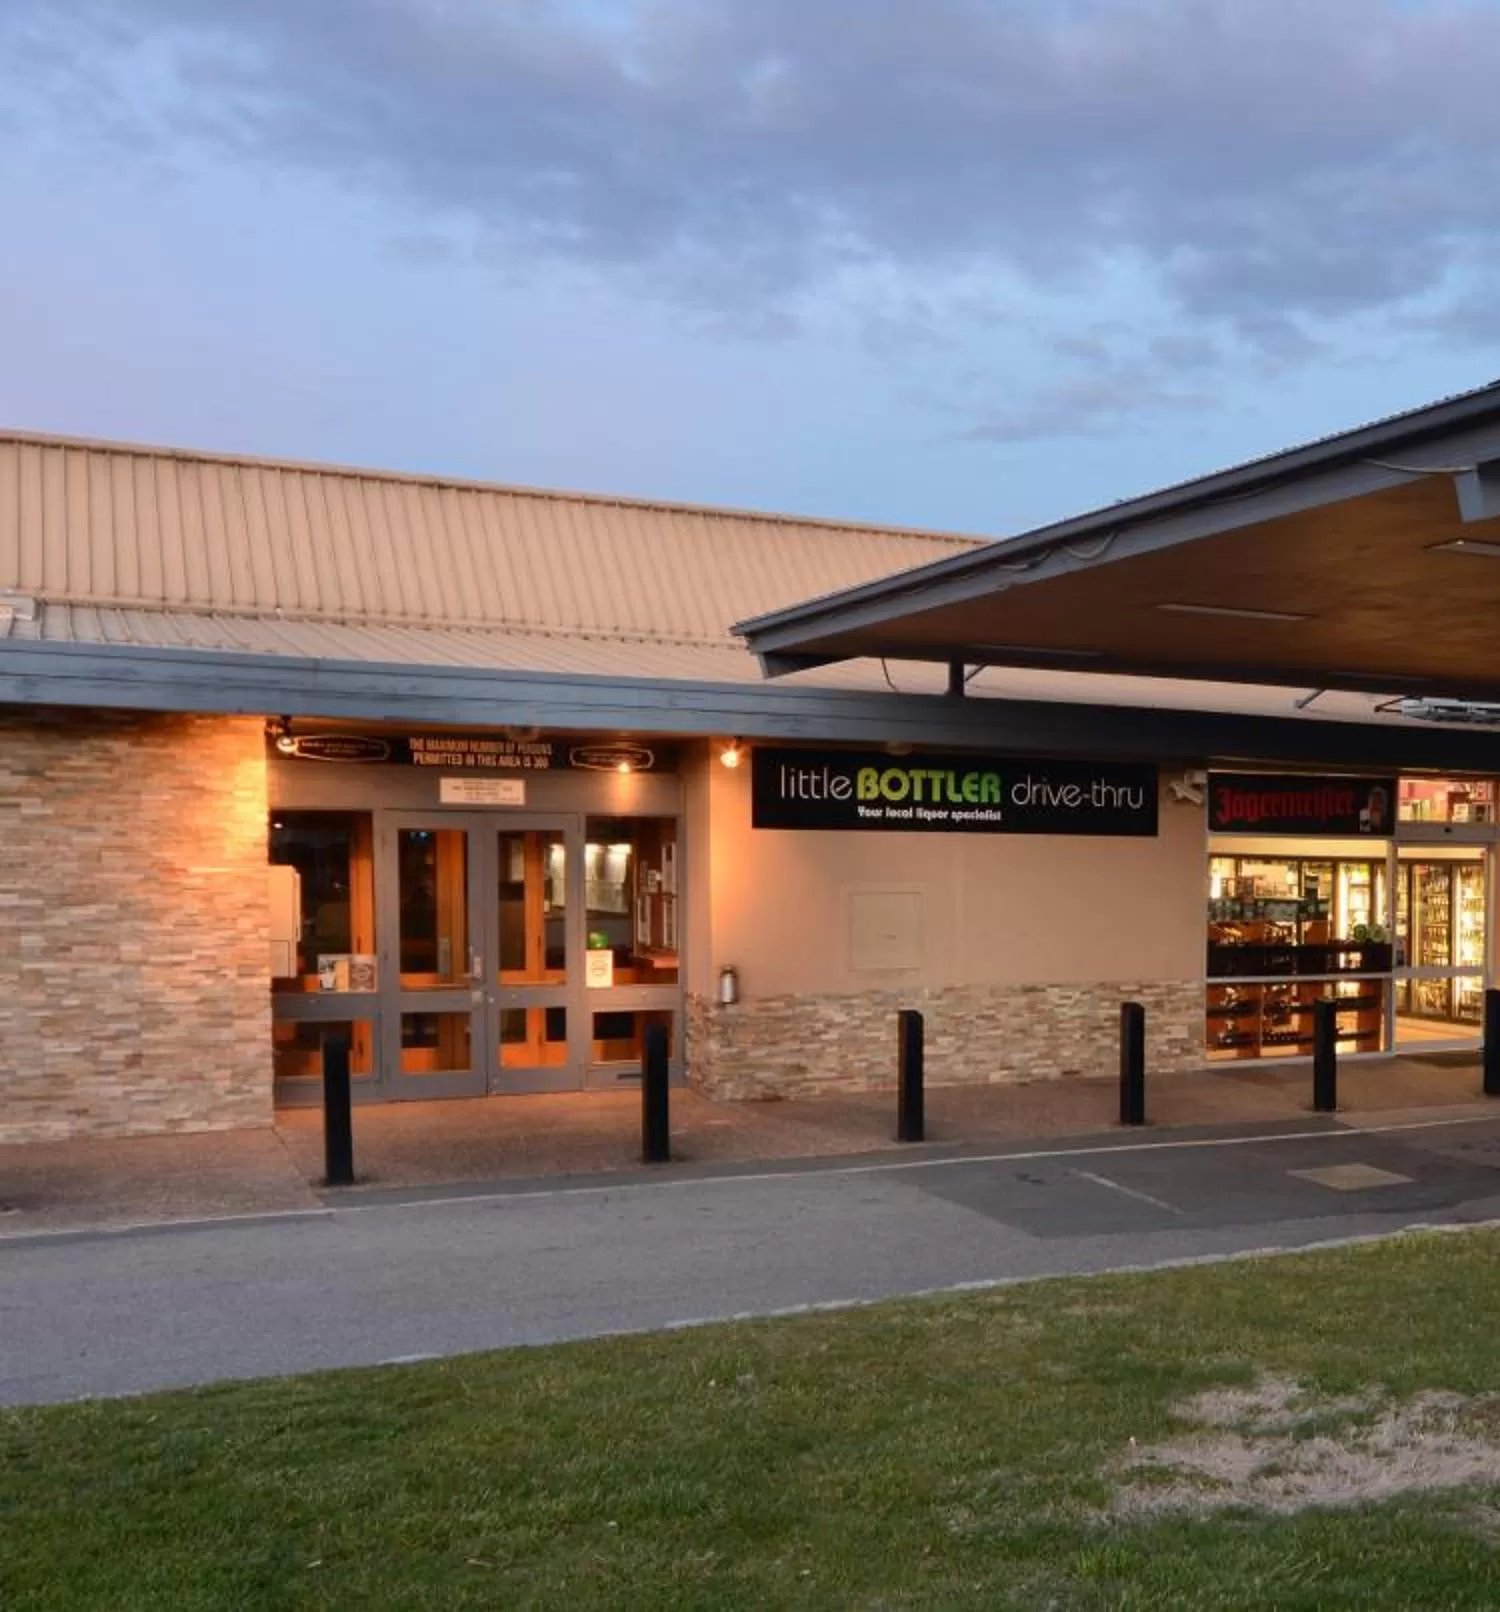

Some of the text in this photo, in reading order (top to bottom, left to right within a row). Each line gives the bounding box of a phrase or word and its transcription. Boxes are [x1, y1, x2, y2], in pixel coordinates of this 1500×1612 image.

[413, 752, 462, 765] PERMITTED
[478, 754, 497, 767] THIS
[499, 755, 520, 768] AREA
[780, 764, 1143, 809] little BOTTLER drive-thru
[857, 805, 1002, 822] Your local liquor specialist
